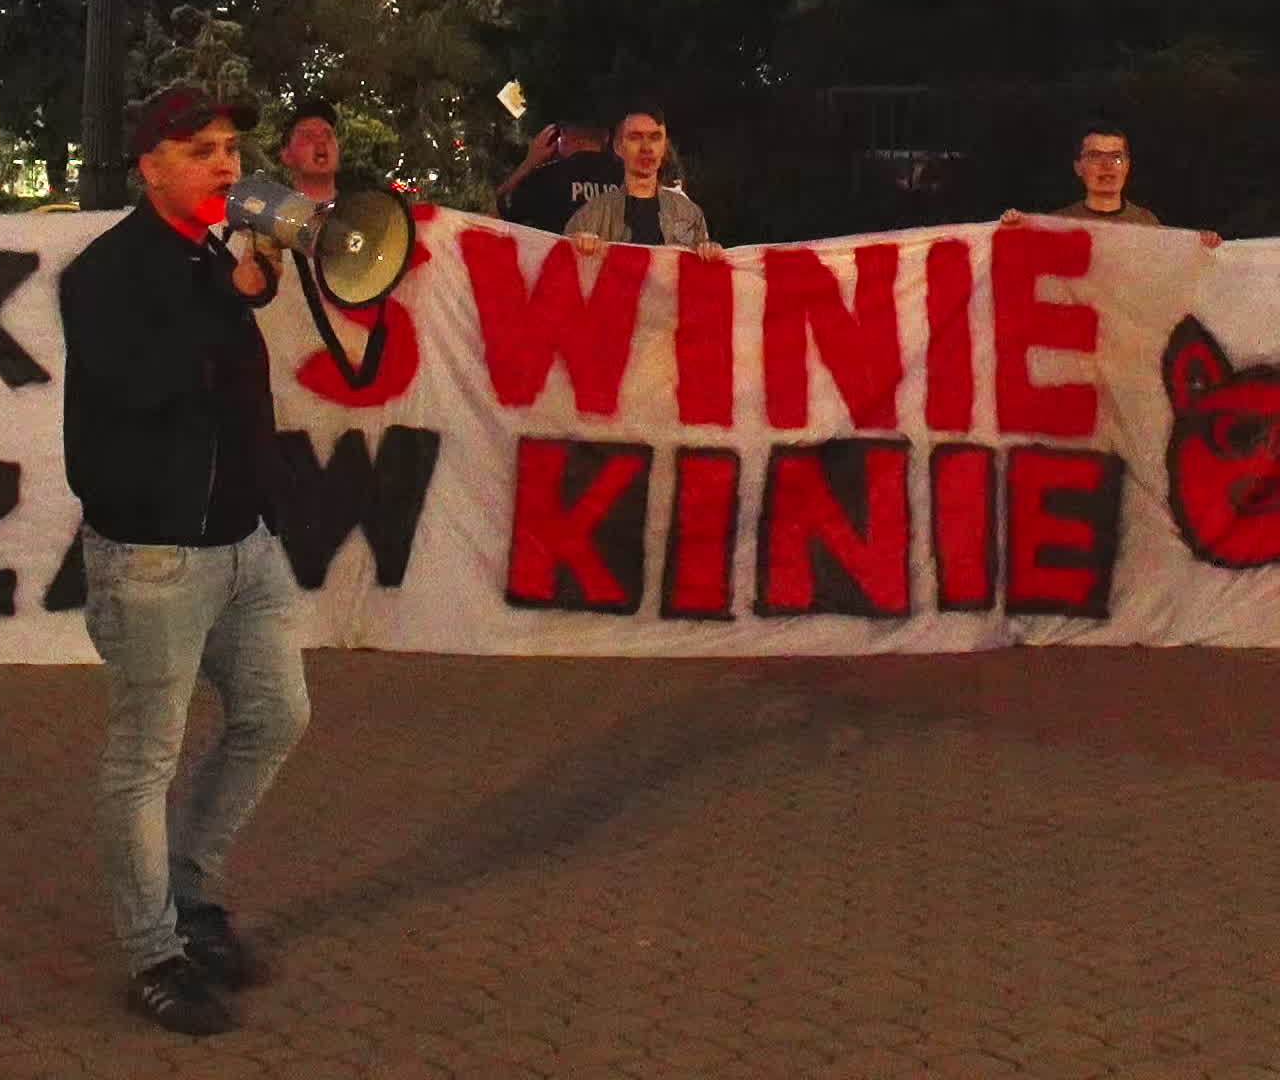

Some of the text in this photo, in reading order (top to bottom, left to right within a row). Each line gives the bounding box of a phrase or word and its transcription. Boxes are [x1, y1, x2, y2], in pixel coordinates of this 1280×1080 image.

[570, 181, 624, 201] POLIC
[270, 423, 442, 591] W
[504, 434, 1129, 621] KINIE
